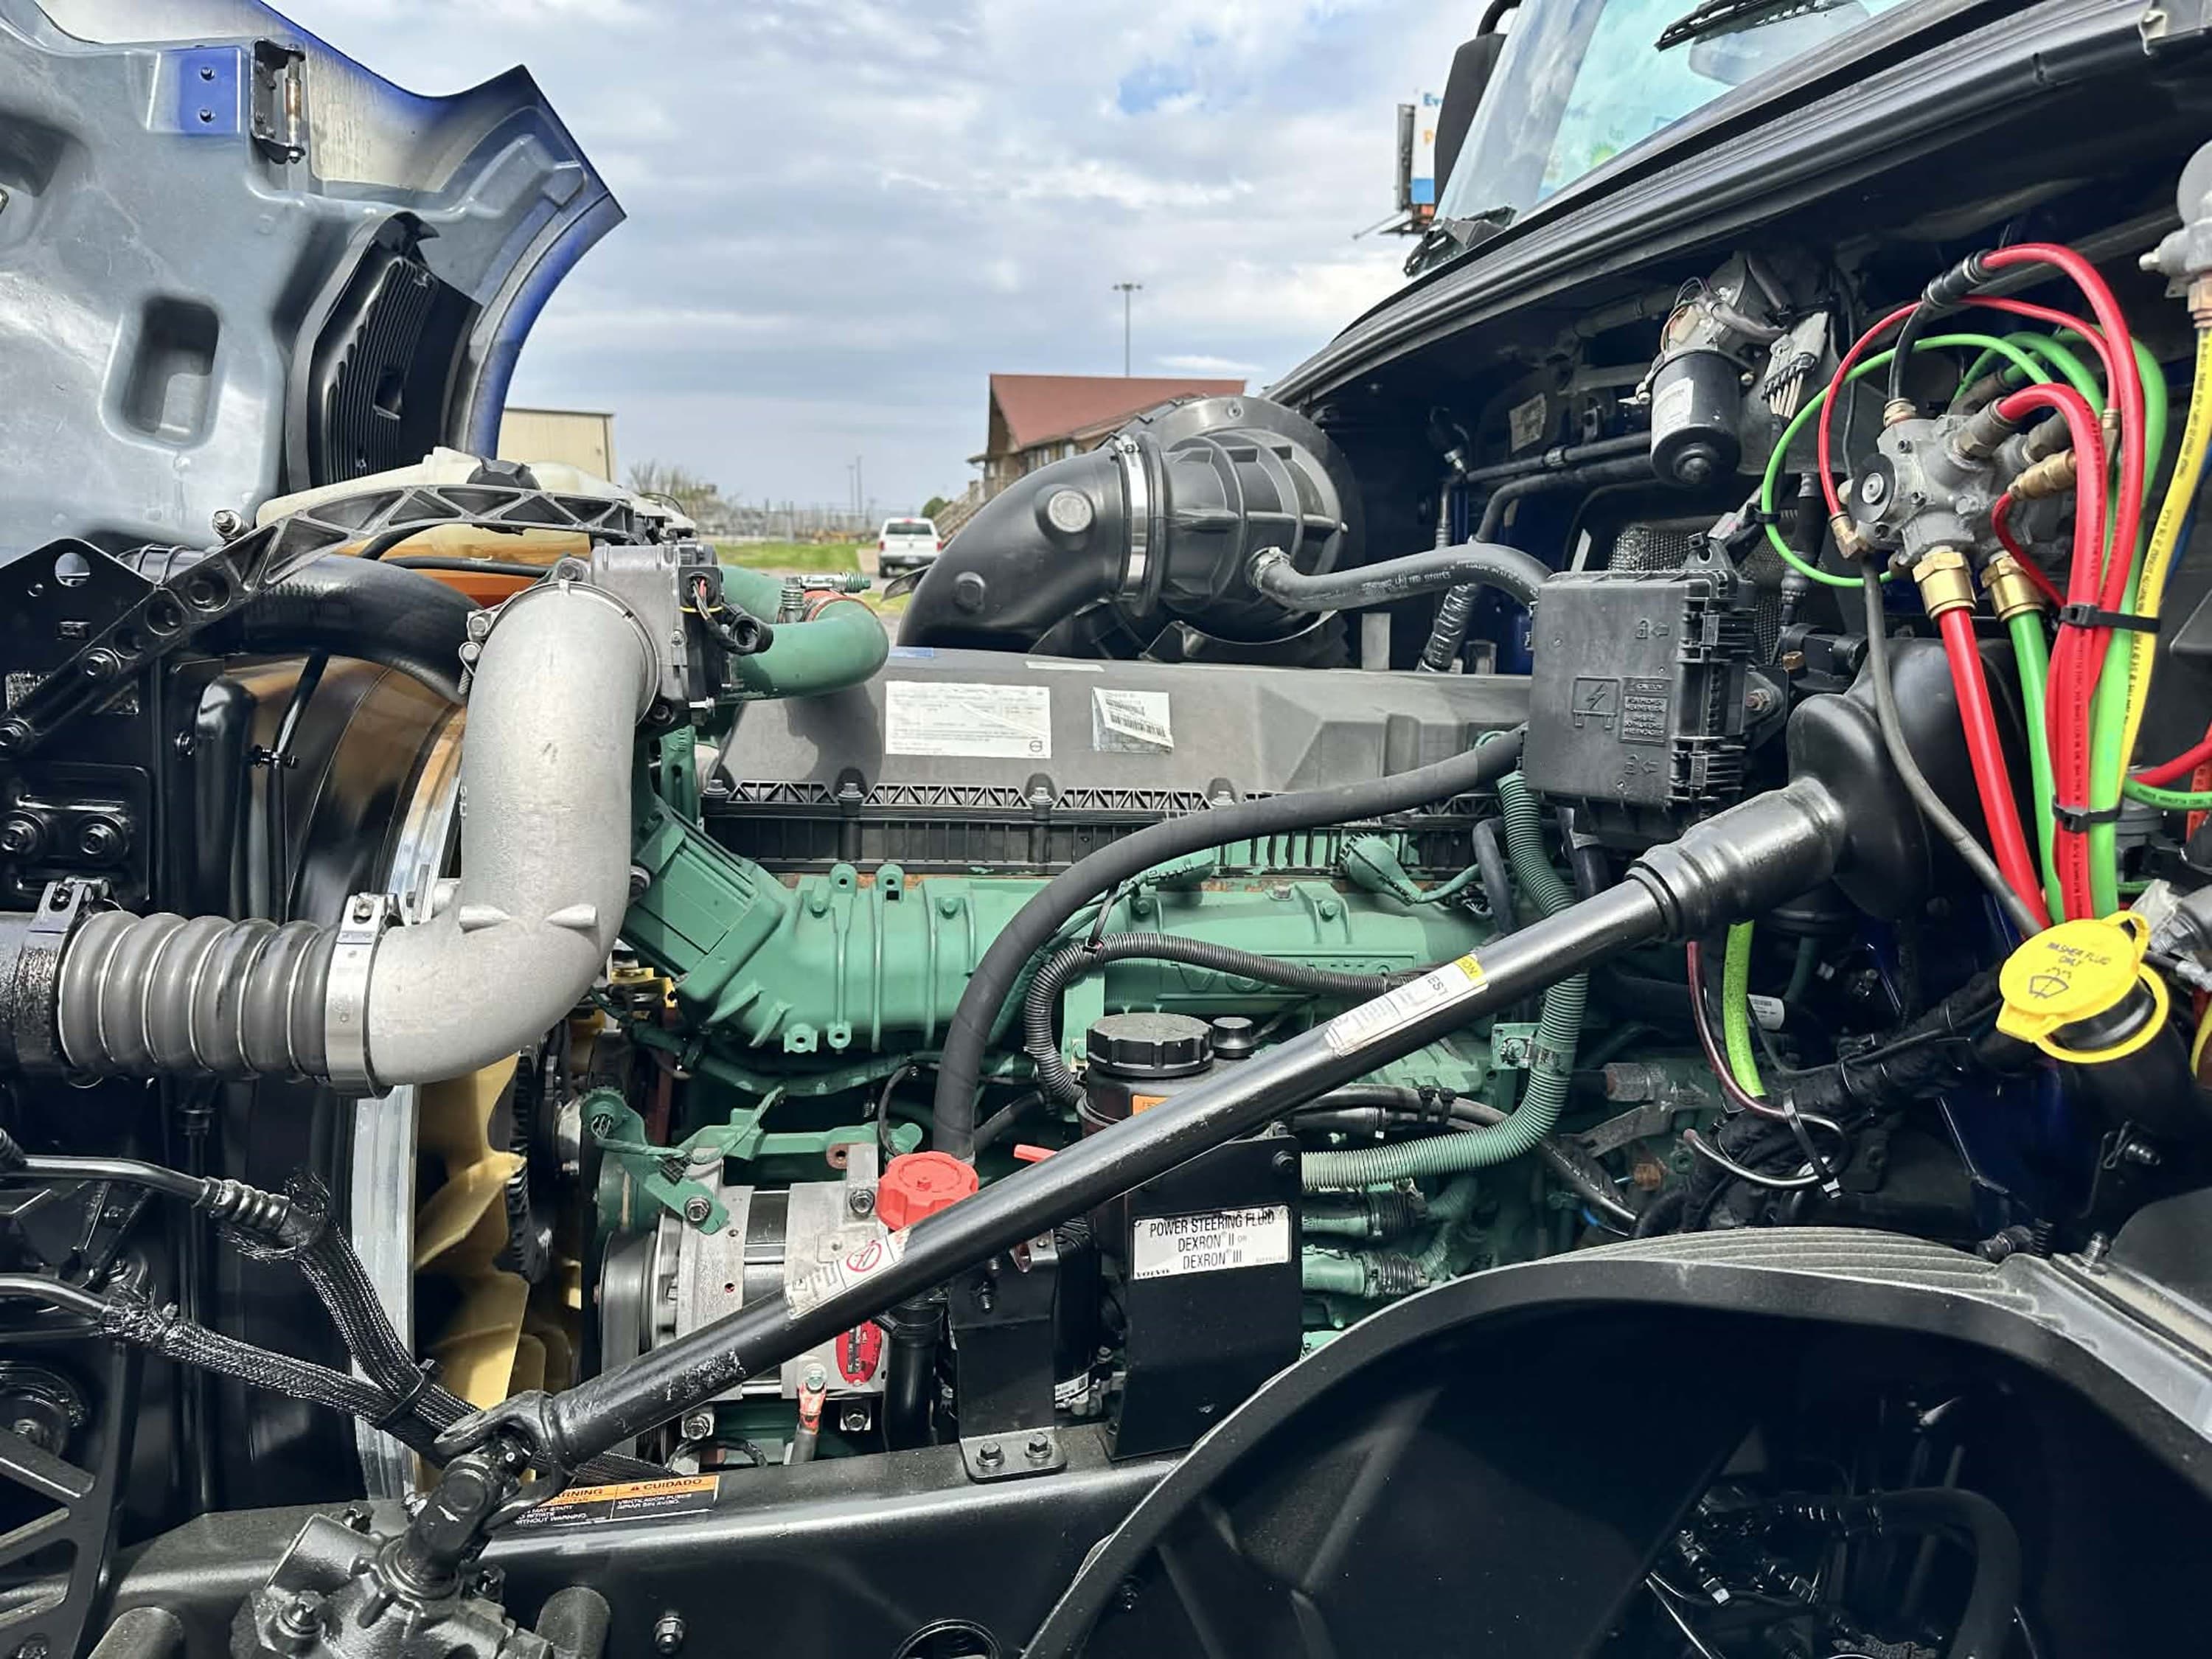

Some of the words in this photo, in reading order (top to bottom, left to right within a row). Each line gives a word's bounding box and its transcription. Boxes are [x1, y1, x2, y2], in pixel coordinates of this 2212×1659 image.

[1150, 1219, 1188, 1237] POWER
[1191, 1214, 1243, 1234] STEERING
[1245, 1208, 1275, 1227] FLUID
[1228, 1233, 1234, 1245] II
[1233, 1250, 1242, 1263] III
[643, 1478, 703, 1490] CUIDADO
